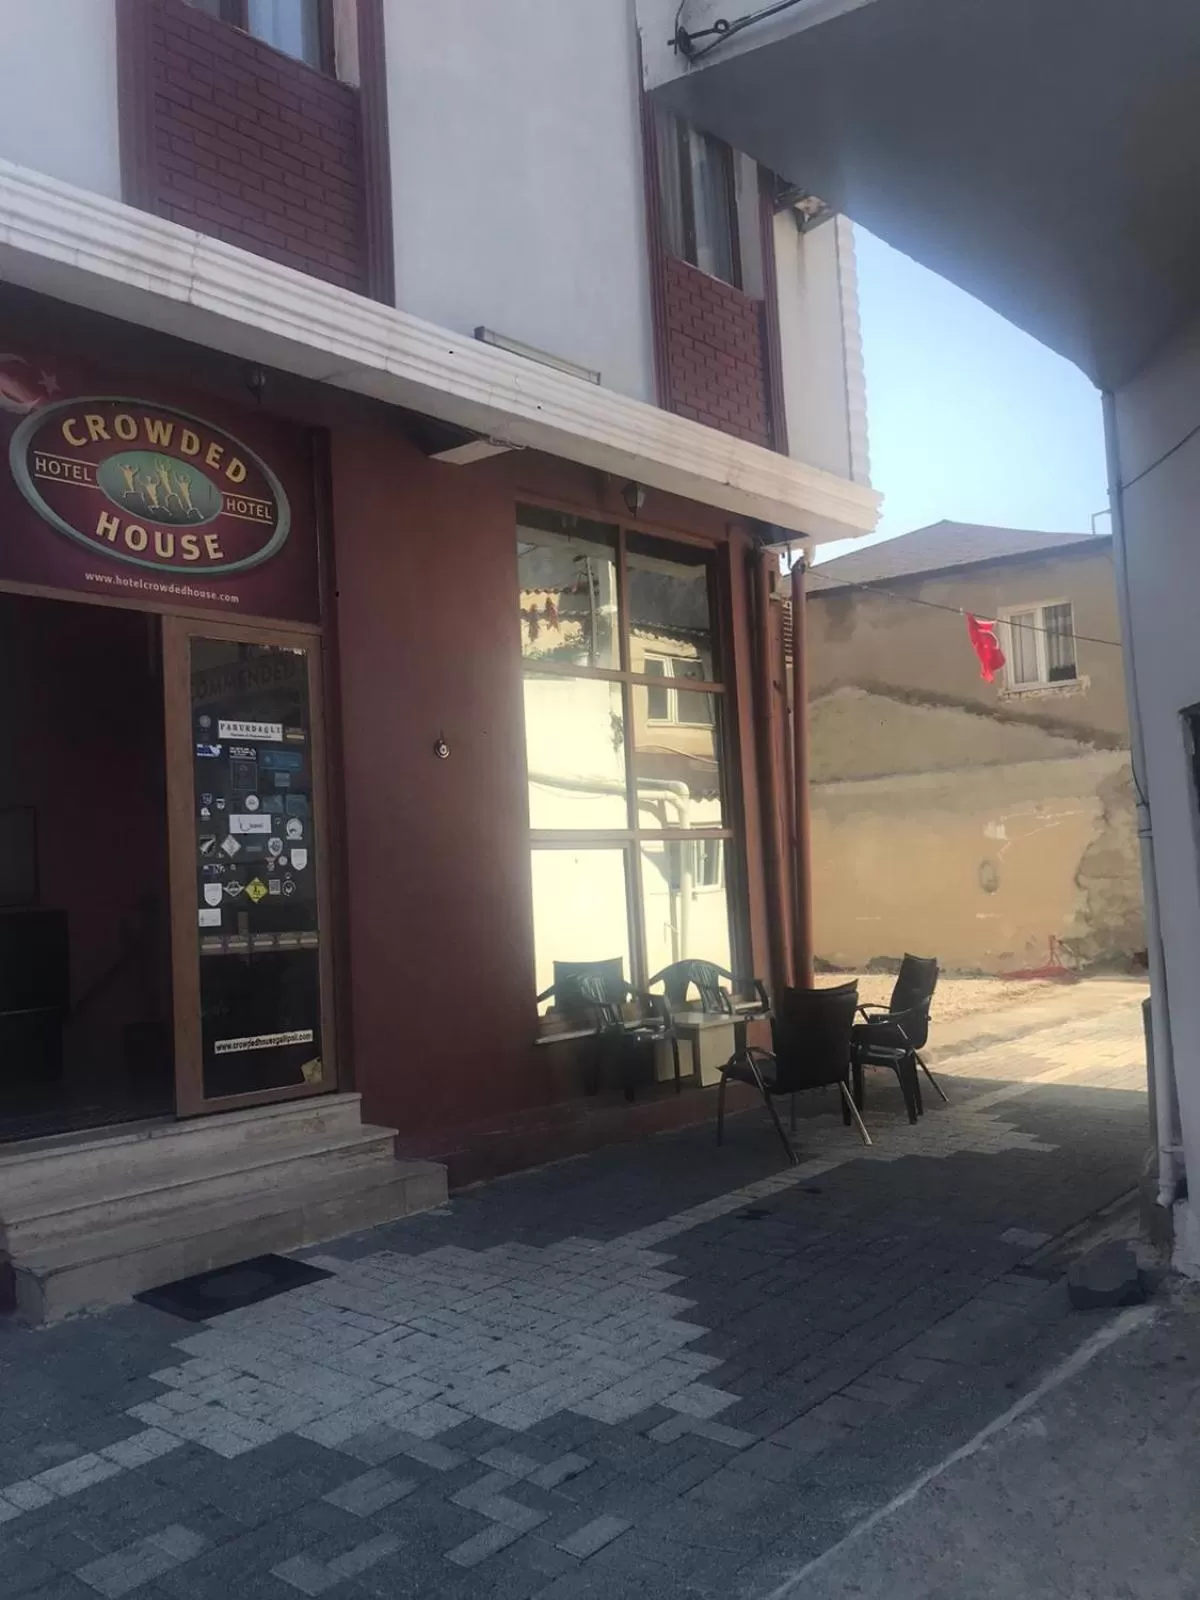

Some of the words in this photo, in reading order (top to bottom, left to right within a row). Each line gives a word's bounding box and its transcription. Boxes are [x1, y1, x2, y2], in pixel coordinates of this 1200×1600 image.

[62, 414, 248, 484] CROWDED
[34, 456, 93, 482] HOTEL
[225, 497, 274, 520] HOTEL
[95, 511, 225, 561] HOUSE
[85, 570, 240, 604] www.hotelcrowdedhouse.com
